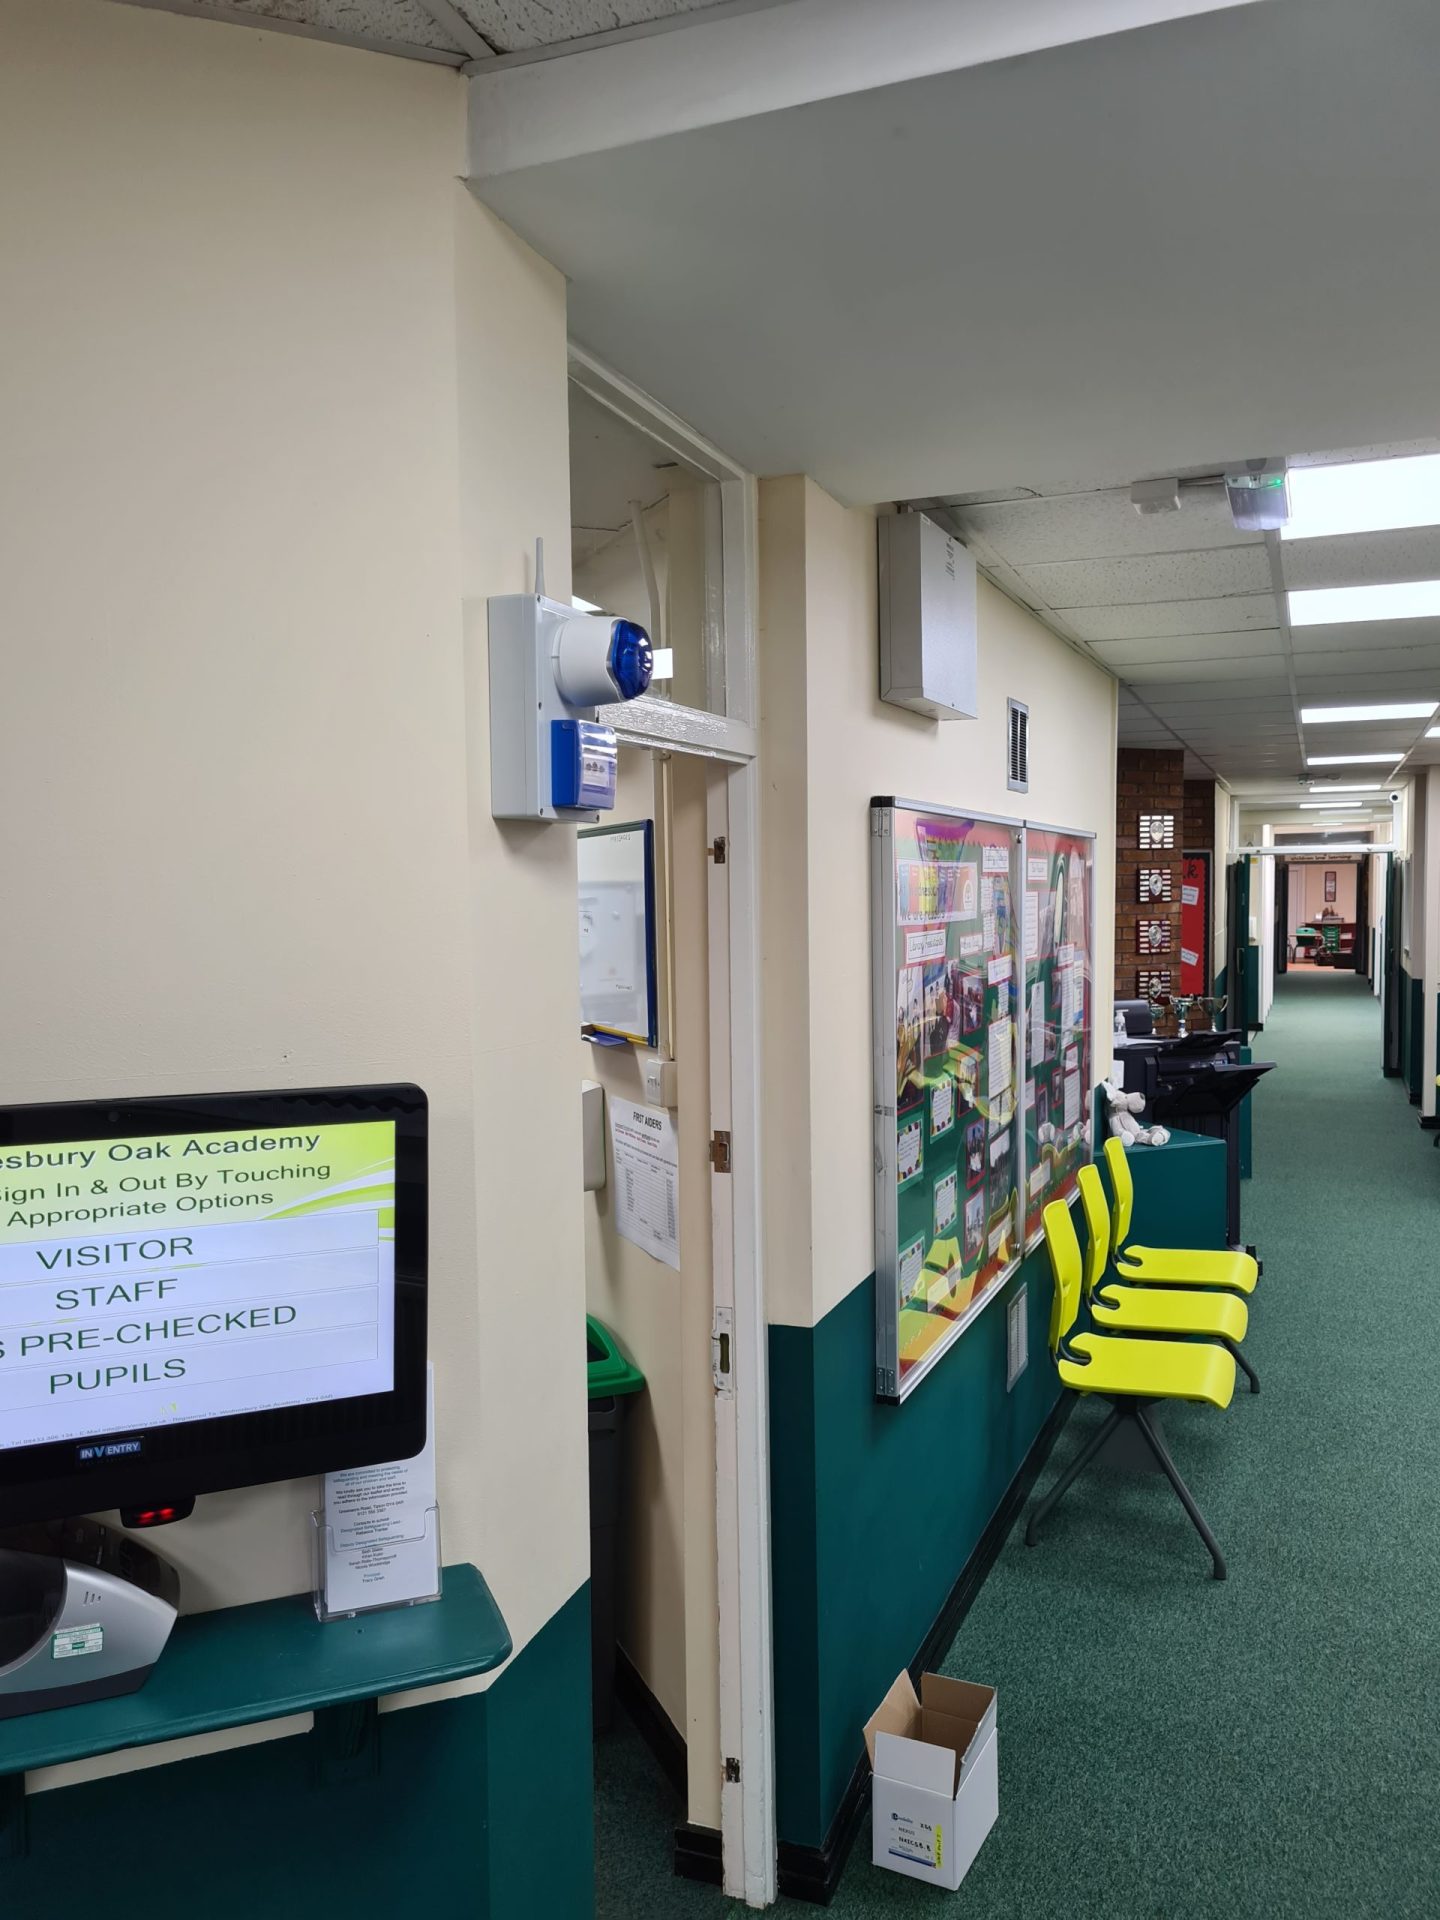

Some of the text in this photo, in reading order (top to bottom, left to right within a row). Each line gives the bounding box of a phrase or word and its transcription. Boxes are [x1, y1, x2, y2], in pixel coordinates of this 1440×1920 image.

[645, 1117, 662, 1131] AIDERS
[0, 1134, 321, 1169] sbury Oak Academy
[0, 1164, 331, 1206] ign In & Out By Touching
[6, 1192, 274, 1229] Appropriate Options
[36, 1237, 194, 1270] VISITOR
[55, 1278, 178, 1311] STAFF
[20, 1305, 297, 1357] PRE-CHECKED
[50, 1358, 187, 1395] PUPILS
